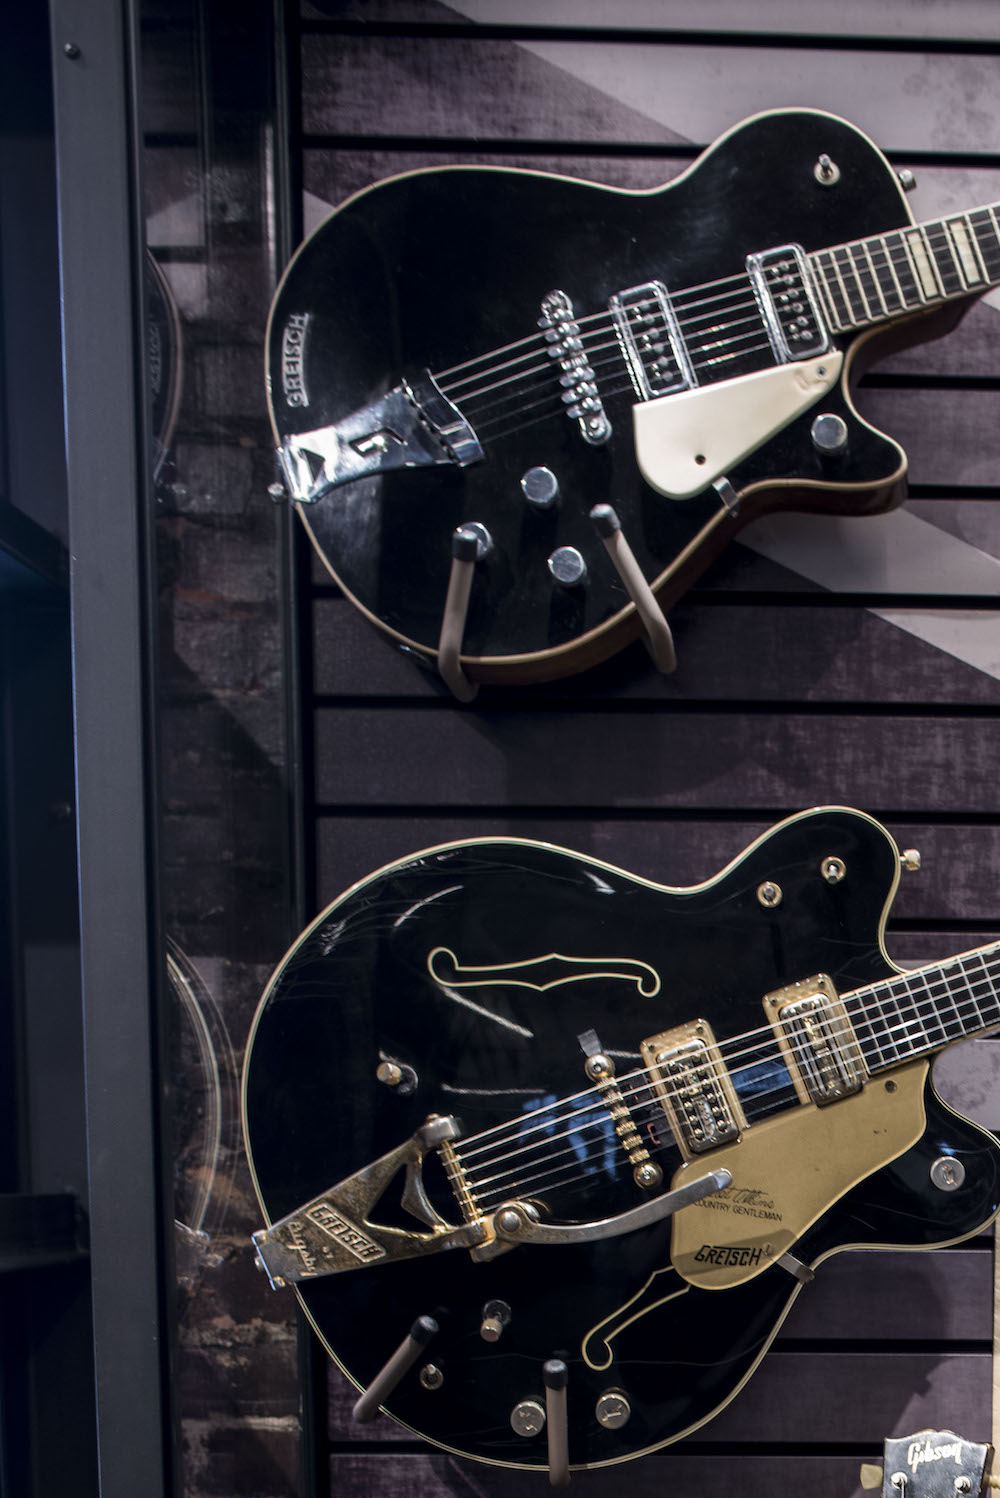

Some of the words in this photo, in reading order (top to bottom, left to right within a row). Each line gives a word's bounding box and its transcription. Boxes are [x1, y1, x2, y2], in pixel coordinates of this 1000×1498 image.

[732, 1205, 782, 1221] GENTLEMAN
[694, 1245, 763, 1266] GRETSCH
[907, 1441, 962, 1474] Gibson
